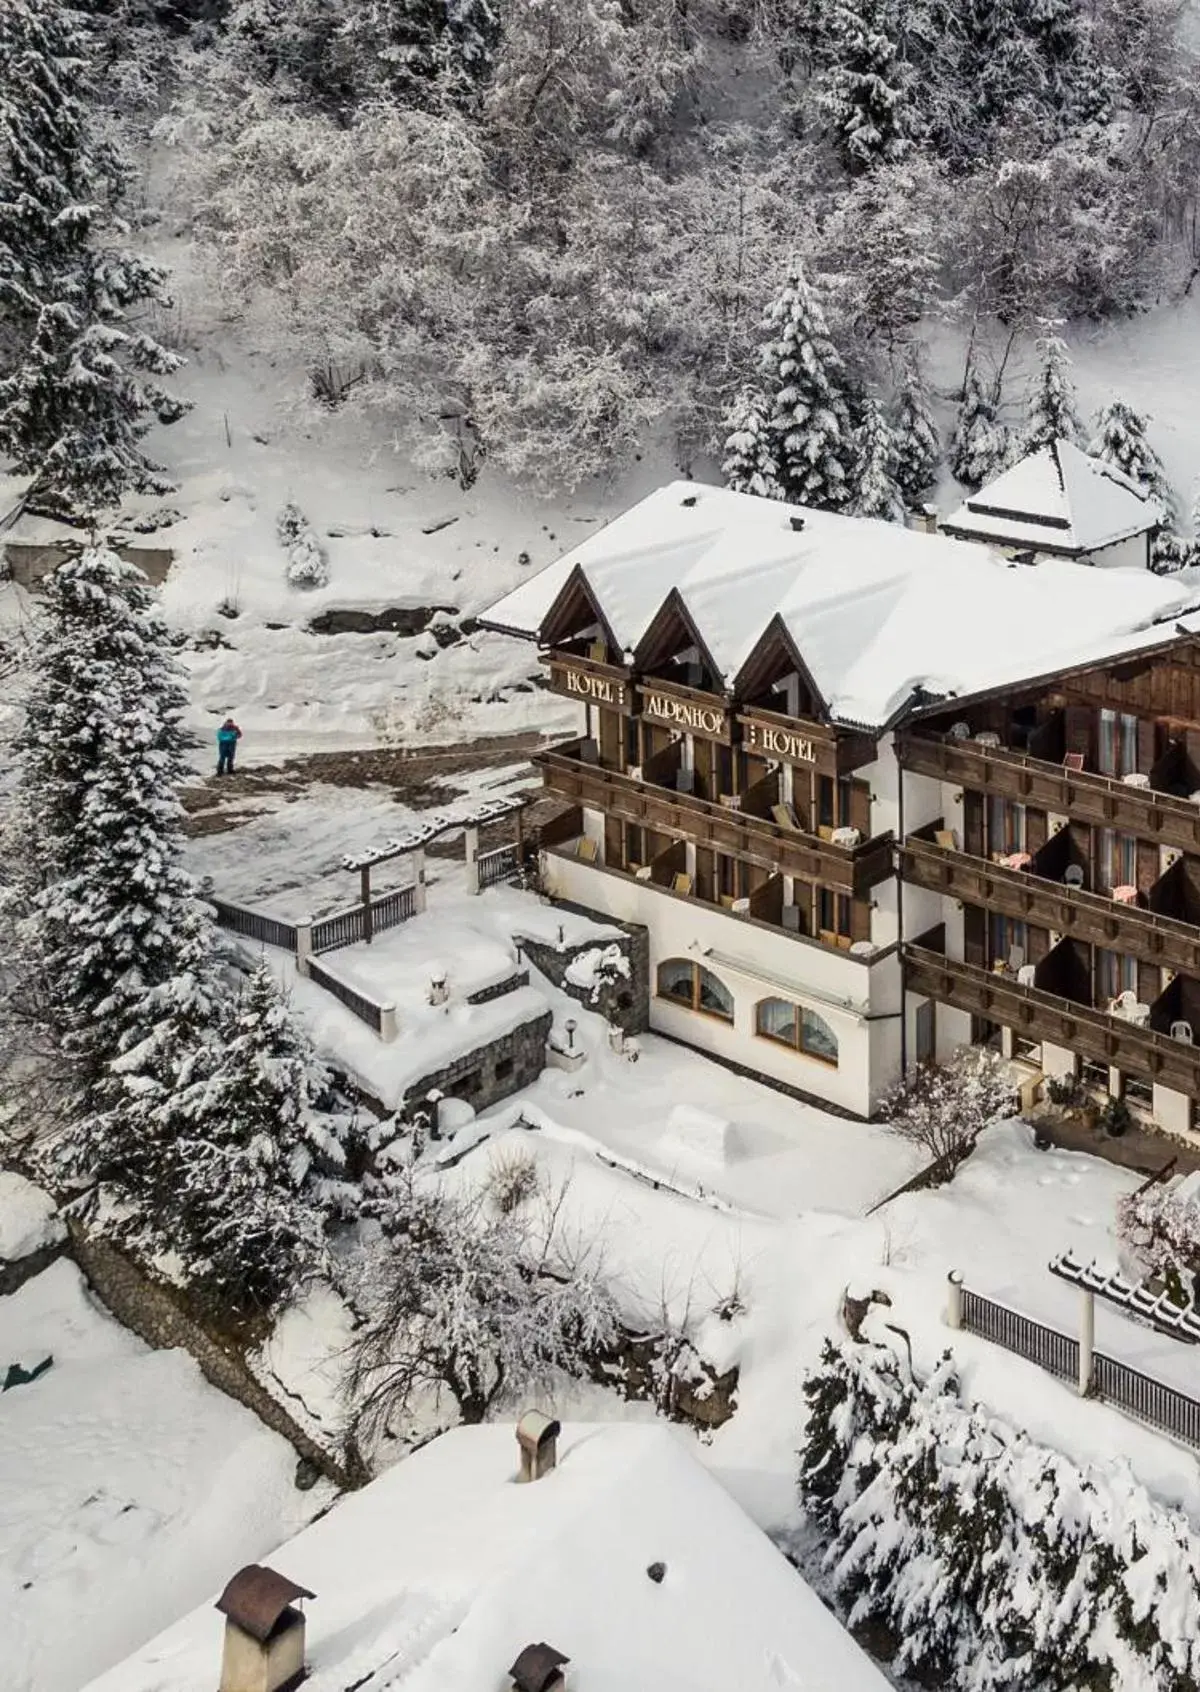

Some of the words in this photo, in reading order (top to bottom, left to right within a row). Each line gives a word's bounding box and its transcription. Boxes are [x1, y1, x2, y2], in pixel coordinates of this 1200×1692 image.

[567, 671, 613, 703] HOTEL
[648, 695, 724, 733] ALPENHOF
[763, 728, 816, 763] HOTEL
